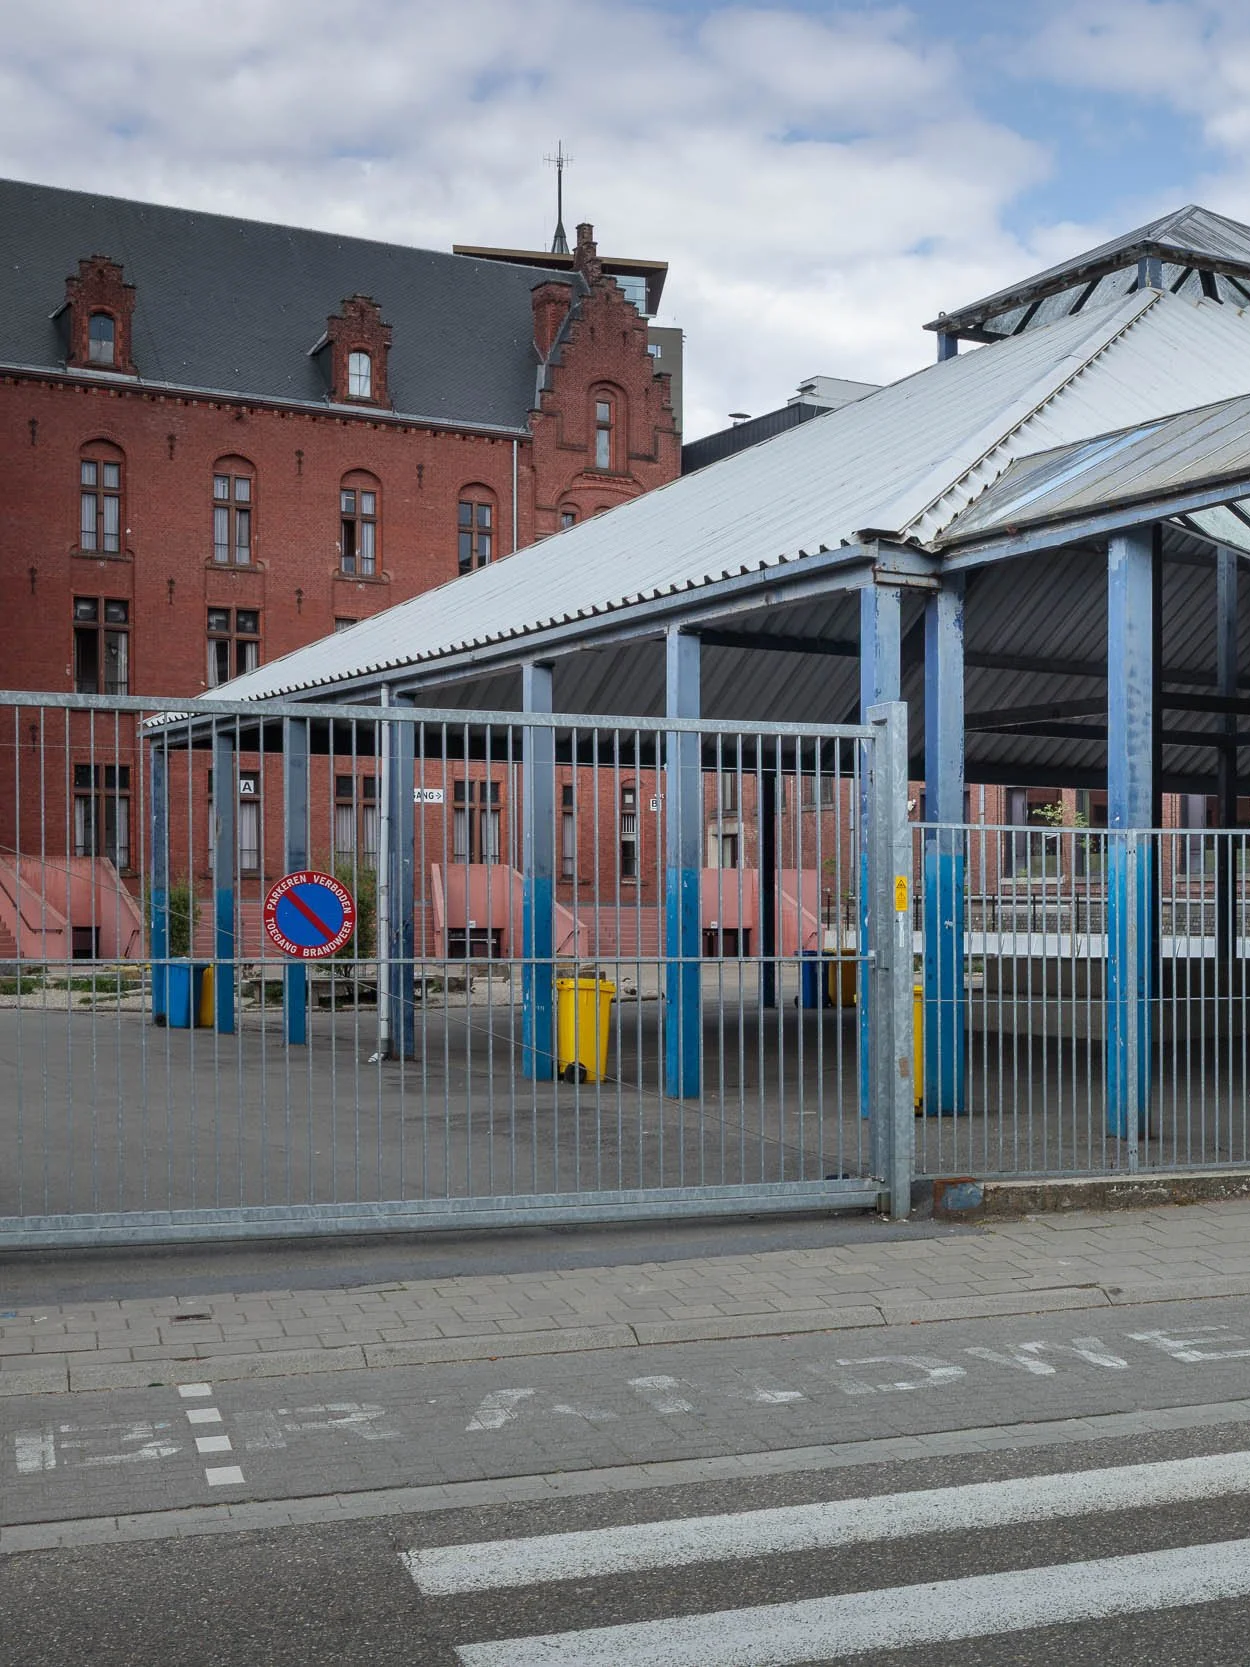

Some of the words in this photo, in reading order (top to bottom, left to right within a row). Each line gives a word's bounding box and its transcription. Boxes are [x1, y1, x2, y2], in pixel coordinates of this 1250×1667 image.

[242, 781, 253, 792] A
[266, 874, 307, 911] PARKEREN
[313, 874, 352, 914] VERBODEN
[265, 917, 298, 954] TOEGANG
[302, 920, 353, 957] BRANDWEER
